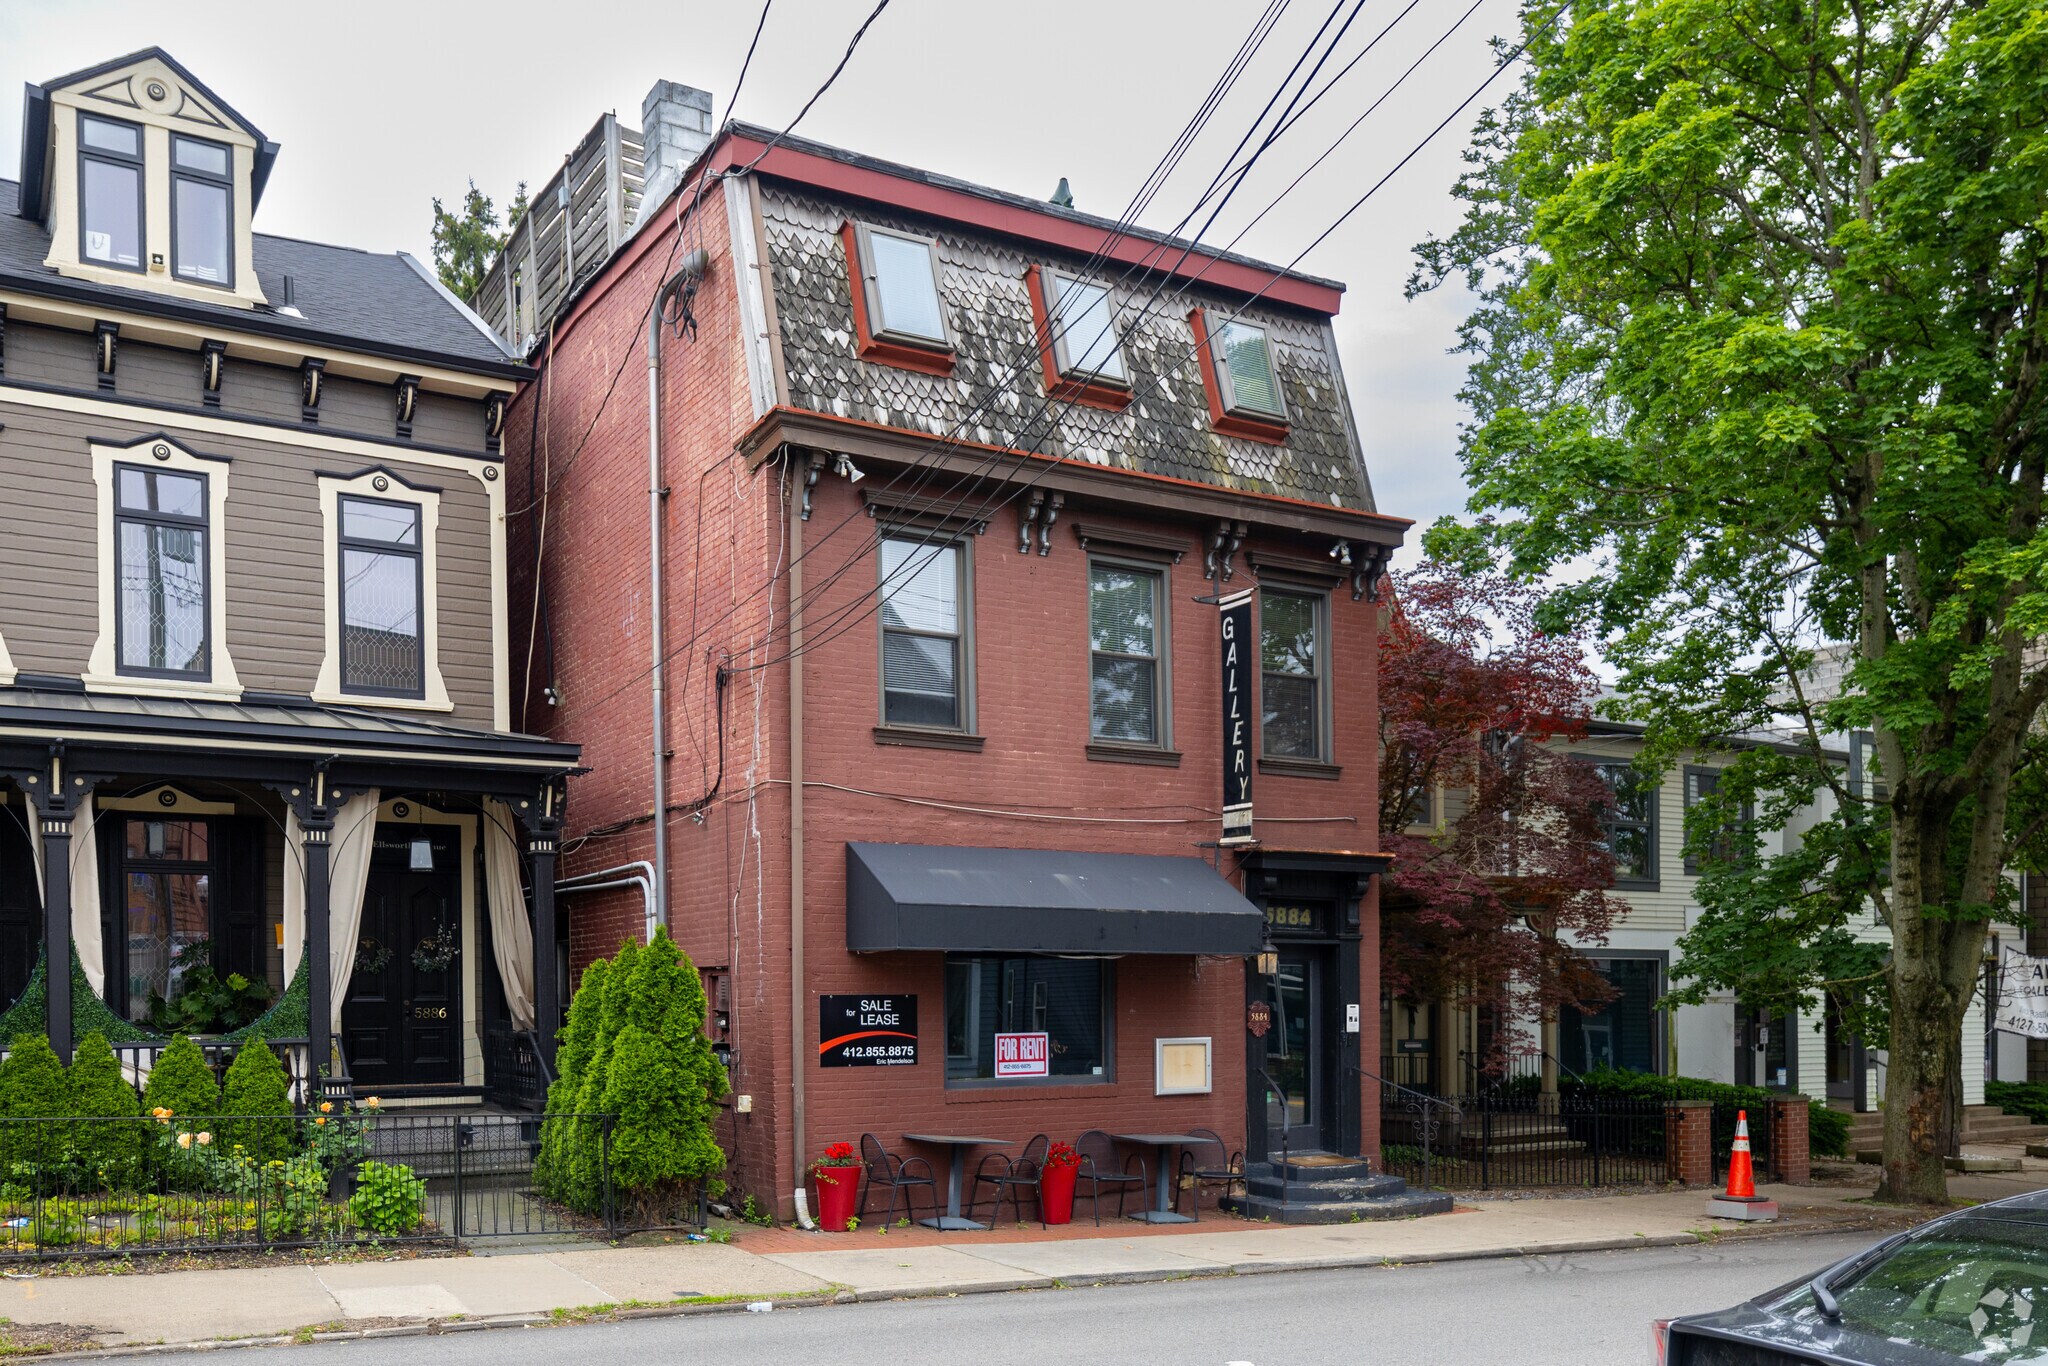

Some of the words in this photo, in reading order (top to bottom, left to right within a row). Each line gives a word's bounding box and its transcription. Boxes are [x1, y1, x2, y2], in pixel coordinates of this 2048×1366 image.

[1222, 616, 1249, 800] GALLERY
[1266, 907, 1312, 926] 5884
[860, 999, 892, 1011] SALE
[414, 1007, 447, 1019] 5886
[1251, 1012, 1268, 1021] 5884
[860, 1014, 899, 1025] LEASE
[842, 1046, 914, 1057] 412.855.8875
[998, 1038, 1018, 1060] FOR
[1020, 1037, 1045, 1060] RENT
[887, 1057, 914, 1065] Mendelson
